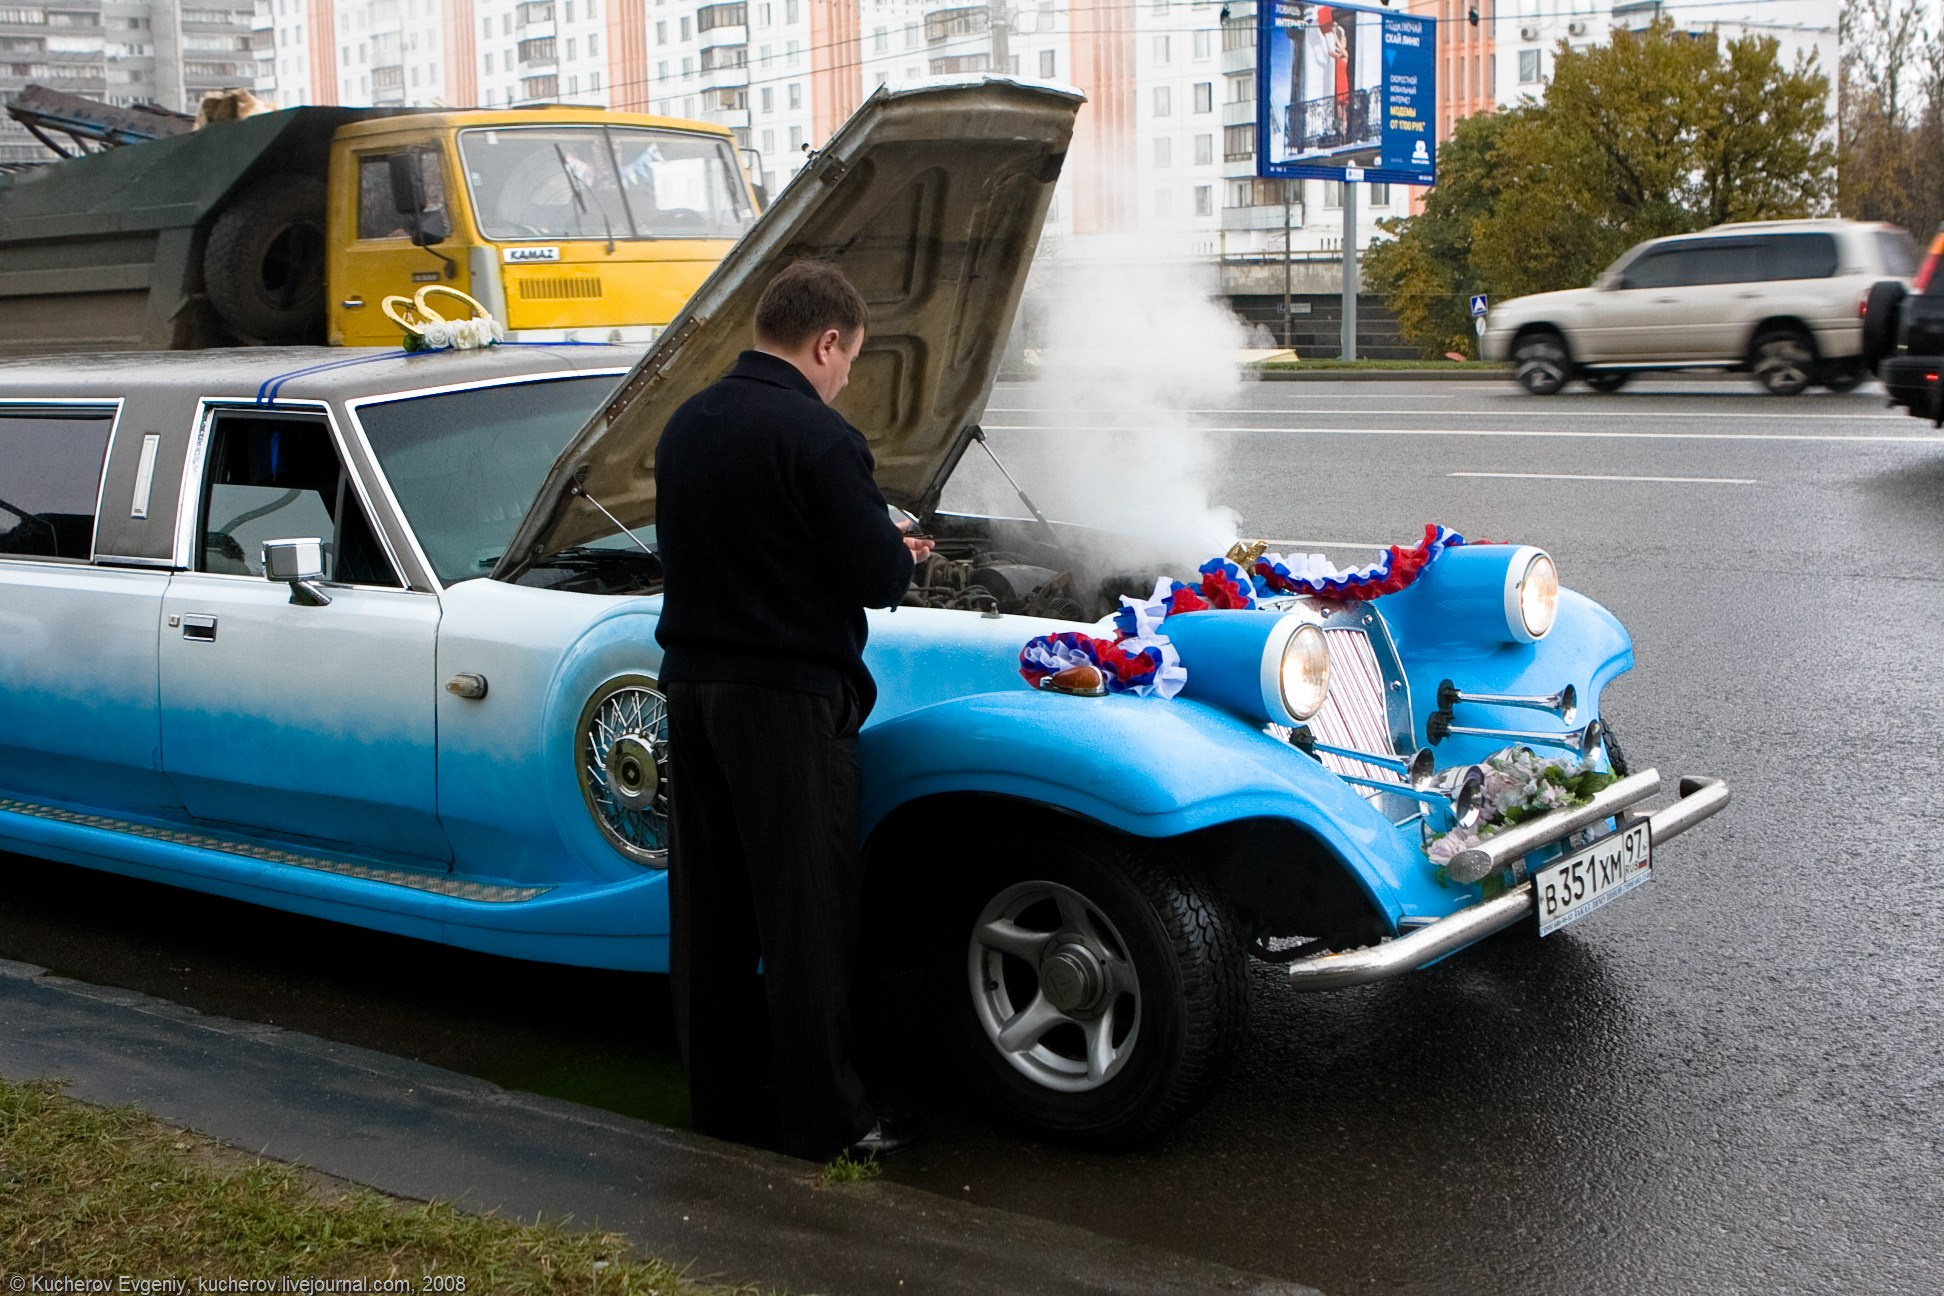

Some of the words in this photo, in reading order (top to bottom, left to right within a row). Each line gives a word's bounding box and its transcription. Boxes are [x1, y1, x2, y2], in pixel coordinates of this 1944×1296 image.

[1390, 106, 1416, 118] МОДЕМЫ
[1390, 119, 1398, 130] ОТ
[511, 249, 553, 260] KAMAZ
[1625, 828, 1642, 863] 97
[1625, 860, 1639, 874] RUS
